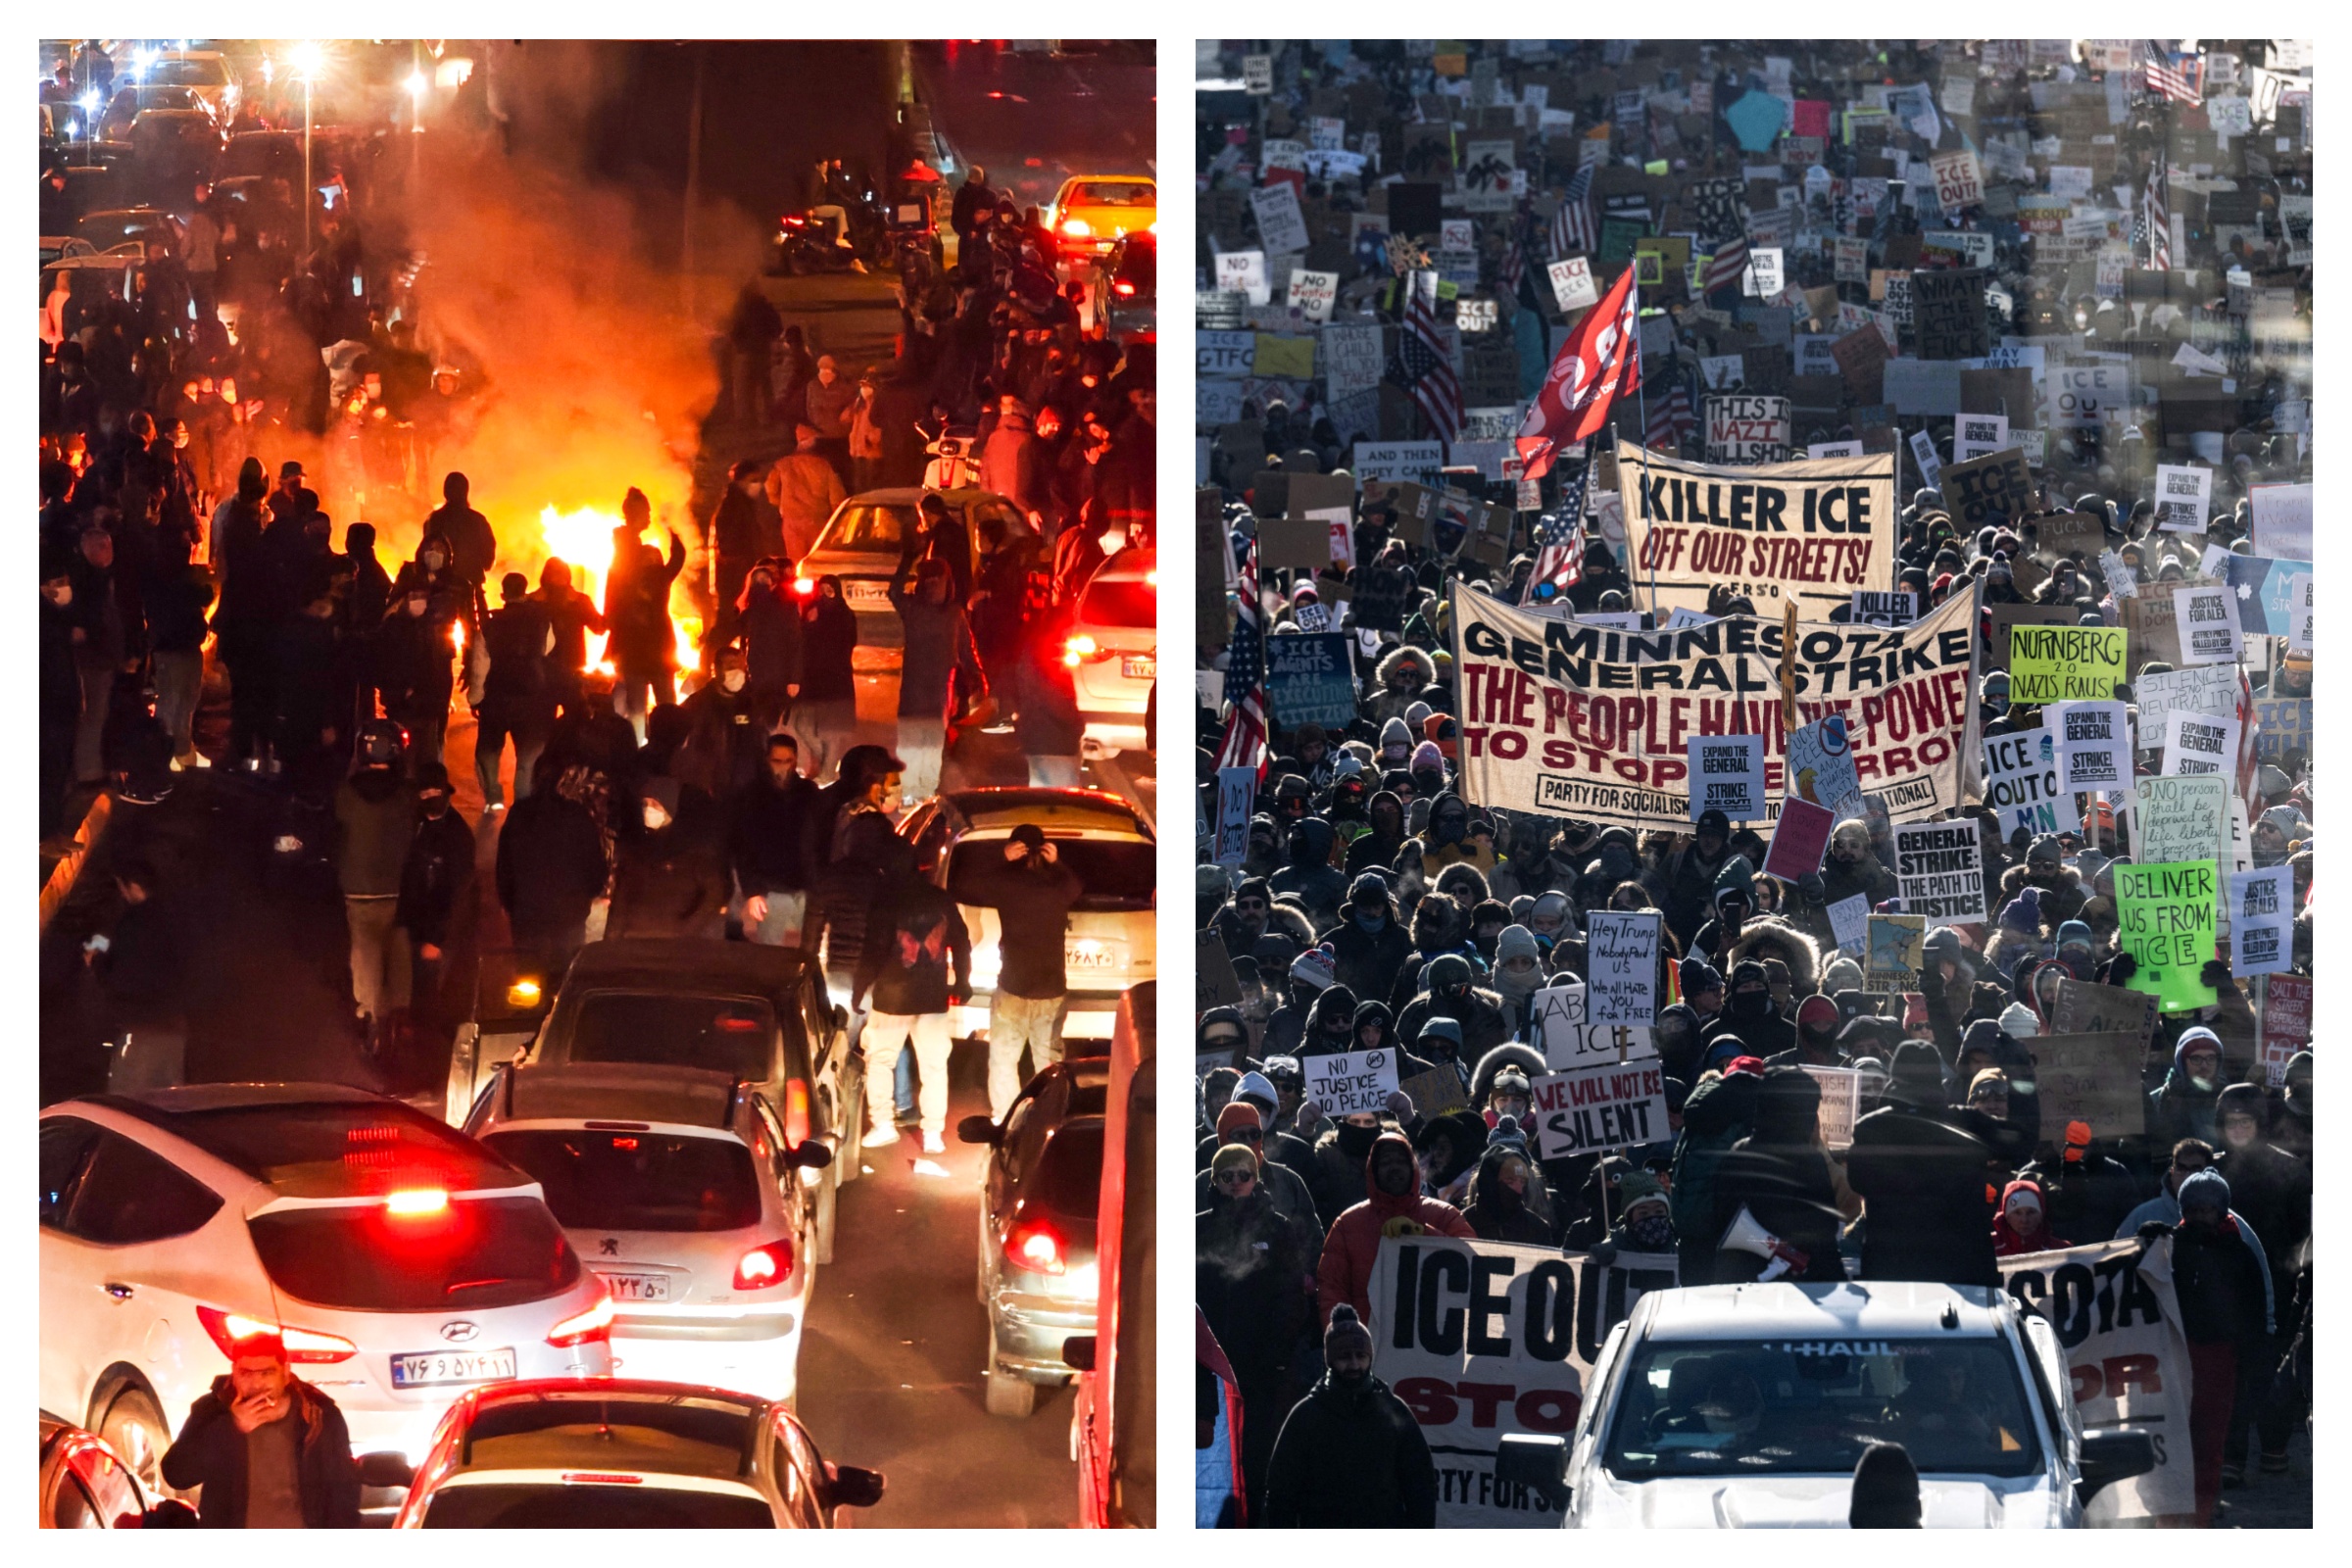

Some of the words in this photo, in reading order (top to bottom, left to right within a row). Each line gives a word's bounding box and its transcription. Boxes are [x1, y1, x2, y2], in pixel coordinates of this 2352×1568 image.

[1936, 165, 1972, 184] ICE
[1941, 182, 1978, 203] OUT!
[1227, 258, 1250, 270] NO
[1552, 261, 1586, 282] FUCK
[1302, 274, 1327, 287] NO
[1917, 275, 1980, 300] WHAT
[1299, 297, 1322, 311] NO
[1458, 299, 1496, 317] ICE
[1923, 299, 1971, 317] THE
[1209, 333, 1244, 346] ICE
[1336, 342, 1375, 357] CHILD
[2063, 369, 2108, 389] ICE
[1709, 397, 1767, 421] THIS
[1771, 398, 1790, 424] IS
[2059, 393, 2119, 422] OUT
[1712, 420, 1780, 443] NAZI
[1965, 431, 1997, 443] GENERAL
[1966, 421, 1986, 432] EXPAND
[1987, 422, 1998, 432] THE
[1402, 449, 1440, 461] THEN
[1707, 443, 1790, 465] BULLSHIT
[1360, 466, 1394, 478] THEY
[1401, 465, 1439, 476] CAME
[2168, 472, 2189, 484] EXPAND
[2190, 475, 2201, 484] THE
[1951, 458, 2028, 507] ICE
[2167, 482, 2199, 497] GENERAL
[1640, 473, 1788, 532] KILLER
[1802, 487, 1872, 534] ICE
[1964, 486, 2030, 523] OUT
[2169, 501, 2197, 514] STRIKE!
[2259, 493, 2307, 510] Trump
[2042, 519, 2087, 536] FUCK
[1640, 526, 1690, 572] OFF
[1690, 530, 1747, 577] OUR
[1752, 537, 1873, 585] STREETS!
[2137, 583, 2176, 601] ICE
[2189, 594, 2224, 611] JUSTICE
[1298, 605, 1322, 619] ICE
[1859, 592, 1911, 614] KILLER
[2188, 610, 2206, 623] FOR
[2207, 608, 2228, 621] ALEX
[1287, 640, 1327, 657] ICE
[1544, 619, 1904, 663] MINNESOTA
[2192, 639, 2210, 649] KILLED
[2211, 639, 2219, 648] BY
[2220, 638, 2231, 647] CBP
[1274, 655, 1335, 673] AGENTS
[1464, 622, 1767, 692] GENERAL
[1776, 628, 1970, 695] STRIKE
[1288, 672, 1323, 688] ARE
[2012, 674, 2059, 699] NAZIS
[2143, 664, 2230, 693] SILENCE
[2189, 683, 2207, 694] NOT
[1274, 682, 1354, 706] EXECUTING
[2138, 689, 2237, 717] NEUTRALITY
[1463, 662, 1537, 728] THE
[1544, 686, 1690, 755] PEOPLE
[2066, 711, 2096, 725] EXPAND
[2097, 710, 2112, 723] THE
[2067, 723, 2113, 742] GENERAL
[2181, 721, 2212, 737] EXPAND
[2212, 726, 2227, 740] THE
[1702, 746, 1733, 759] EXPAND
[1734, 745, 1749, 758] THE
[2180, 733, 2225, 756] GENERAL
[1463, 727, 1528, 760] TO
[1542, 740, 1687, 788] STOP
[1703, 758, 1750, 774] GENERAL
[1790, 736, 1823, 777] ICE!
[1987, 737, 2034, 774] ICE
[2073, 751, 2112, 768] STRIKE!
[1820, 757, 1840, 776] AND
[1230, 783, 1243, 813] DO
[1544, 780, 1590, 803] PARTY
[1592, 787, 1619, 808] FOR
[1621, 792, 1690, 817] SOCIALISM
[1707, 783, 1747, 800] STRIKE!
[1826, 776, 1854, 803] DUSTY
[1993, 773, 2040, 807] OUT
[2152, 780, 2178, 802] NO
[2181, 783, 2221, 801] person
[2150, 800, 2186, 815] shall
[2194, 799, 2211, 811] be
[2016, 802, 2058, 835] MN
[2148, 811, 2195, 831] deprived
[2202, 809, 2215, 826] of
[1897, 827, 1977, 853] GENERAL
[1899, 849, 1980, 876] STRIKE:
[2146, 847, 2156, 857] or
[1901, 877, 1928, 898] THE
[1929, 873, 1962, 896] PATH
[1963, 871, 1982, 892] TO
[2123, 867, 2213, 900] DELIVER
[2245, 878, 2278, 900] JUSTICE
[1832, 898, 1869, 925] END
[1902, 894, 1984, 918] JUSTICE
[2243, 900, 2257, 918] FOR
[2258, 897, 2279, 914] ALEX
[2125, 907, 2146, 933] US
[2157, 902, 2211, 933] FROM
[1591, 918, 1618, 947] Hey
[1618, 918, 1656, 947] Trump
[1596, 945, 1629, 963] Nobody
[1629, 946, 1648, 958] Paid
[2134, 934, 2197, 967] ICE
[2243, 942, 2258, 955] KILLED
[1867, 971, 1919, 981] MINNESOTA
[1592, 980, 1608, 995] We
[2270, 981, 2293, 998] SALT
[2295, 984, 2312, 1000] THE
[1625, 1007, 1652, 1020] FREE
[1328, 1058, 1348, 1076] NO
[1312, 1073, 1379, 1096] JUSTICE
[1534, 1082, 1565, 1112] WE
[1571, 1076, 1611, 1106] WILL
[1610, 1073, 1642, 1103] NOT
[1643, 1069, 1663, 1097] BE
[1340, 1090, 1388, 1111] PEACE
[1547, 1100, 1652, 1154] SILENT
[1393, 1245, 1516, 1357] ICE
[1393, 1377, 1582, 1433] STO
